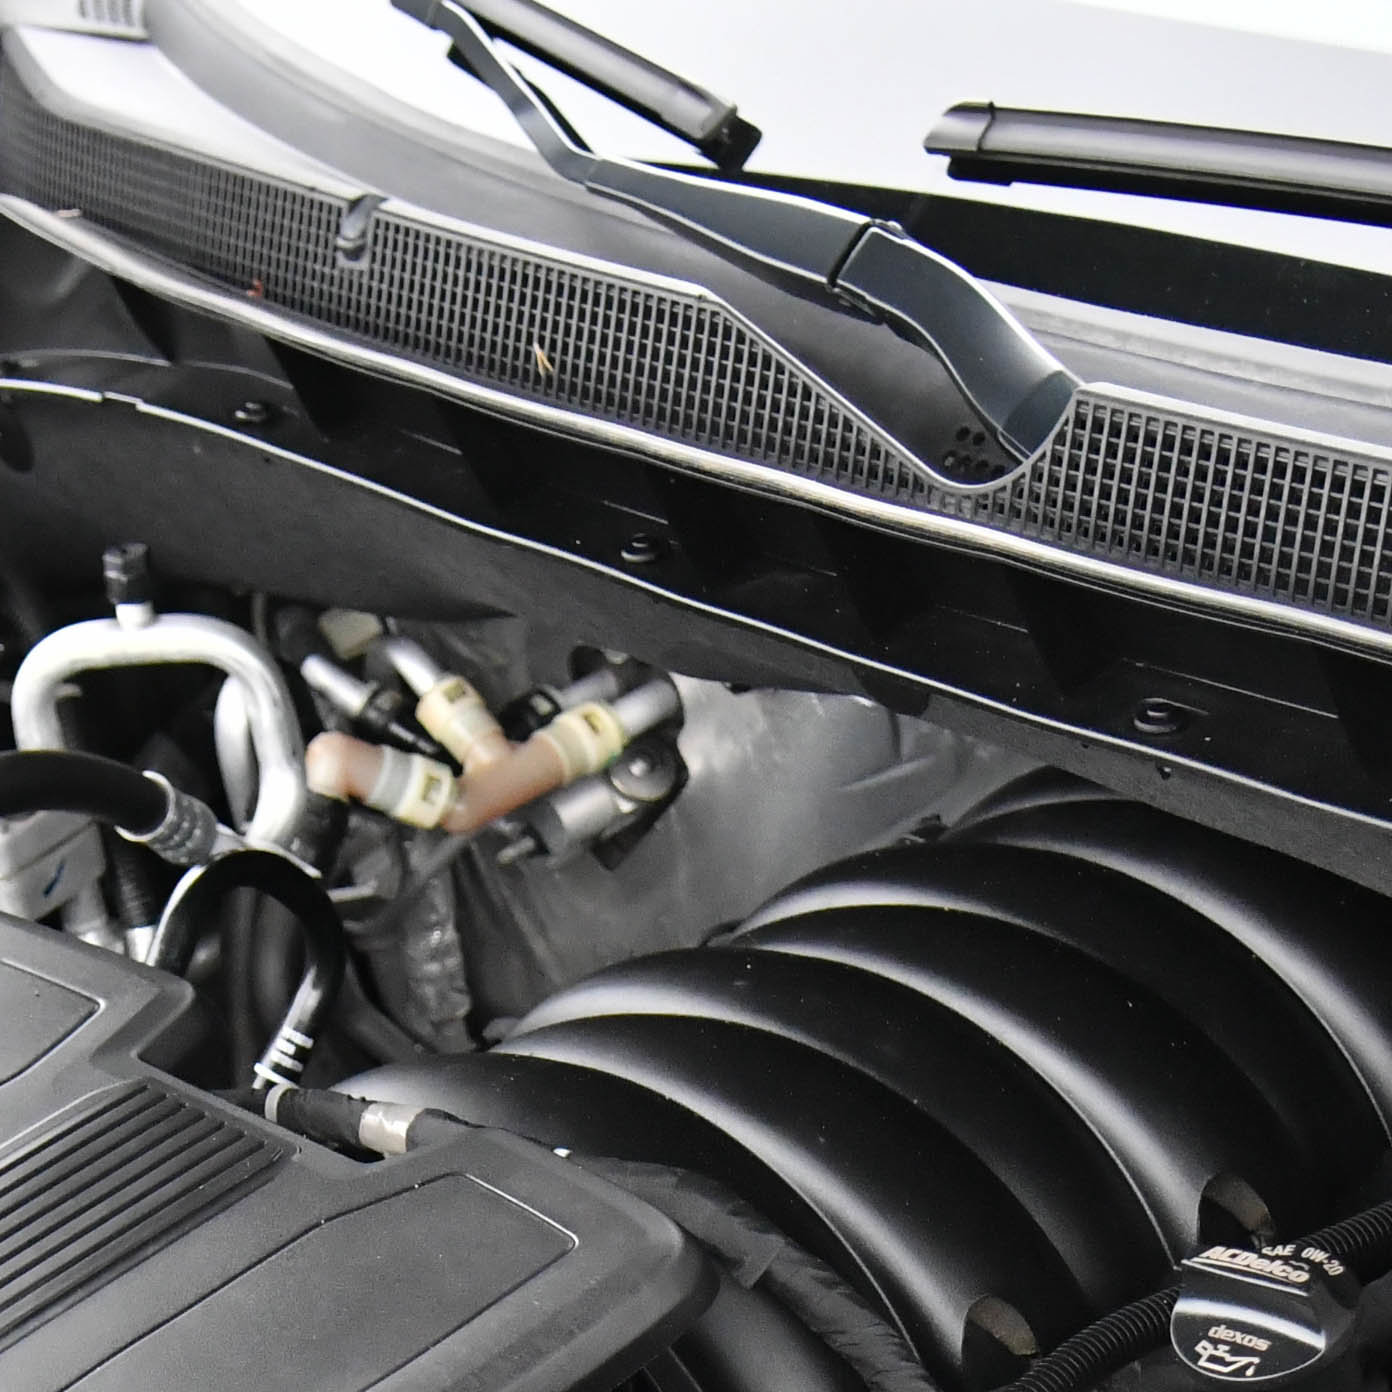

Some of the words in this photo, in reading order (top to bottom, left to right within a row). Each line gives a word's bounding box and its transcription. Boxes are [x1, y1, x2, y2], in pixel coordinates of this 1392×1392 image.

[1199, 1246, 1310, 1283] ACDelco
[1261, 1245, 1296, 1256] SAE
[1301, 1247, 1344, 1276] 0W-20
[1208, 1325, 1272, 1351] dexos
